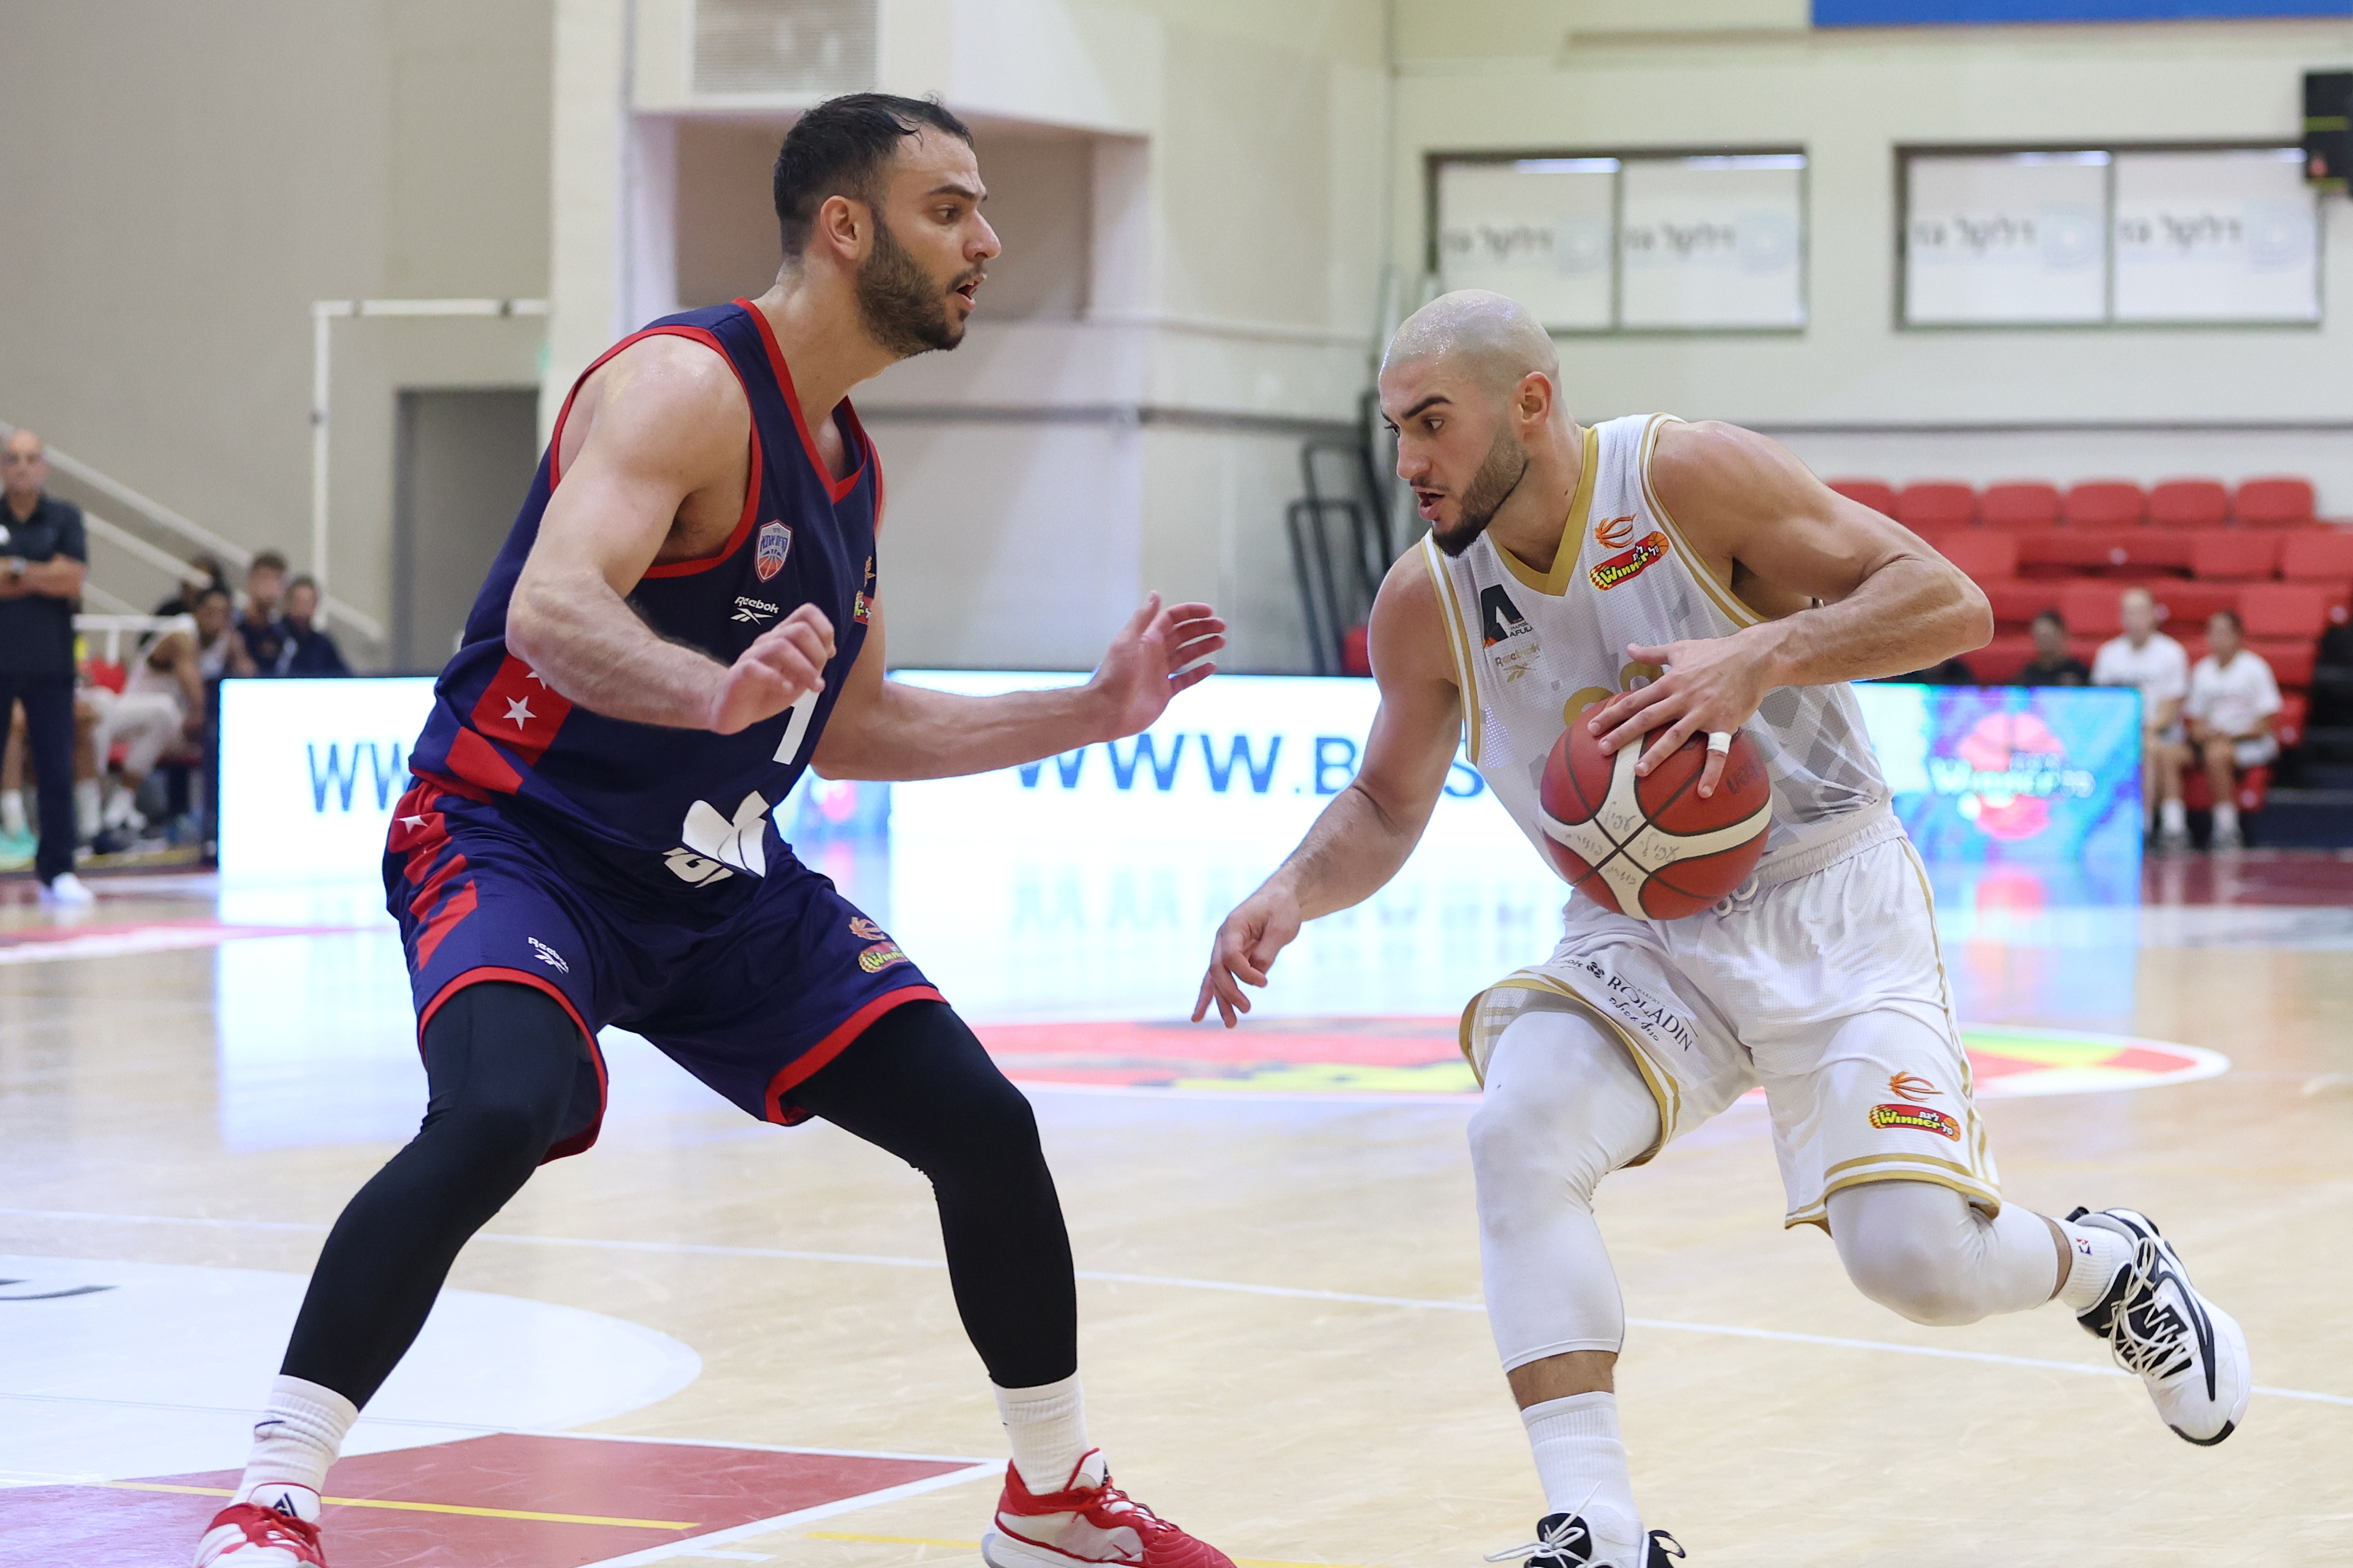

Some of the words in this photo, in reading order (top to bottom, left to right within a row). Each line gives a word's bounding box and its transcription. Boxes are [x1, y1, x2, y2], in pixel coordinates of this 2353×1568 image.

[734, 596, 779, 614] Reebok
[772, 688, 820, 765] 1
[528, 936, 569, 972] Reebok
[1607, 975, 1693, 1052] ROLADIN
[1879, 1110, 1941, 1129] Winner
[1941, 1122, 1954, 1136] סל
